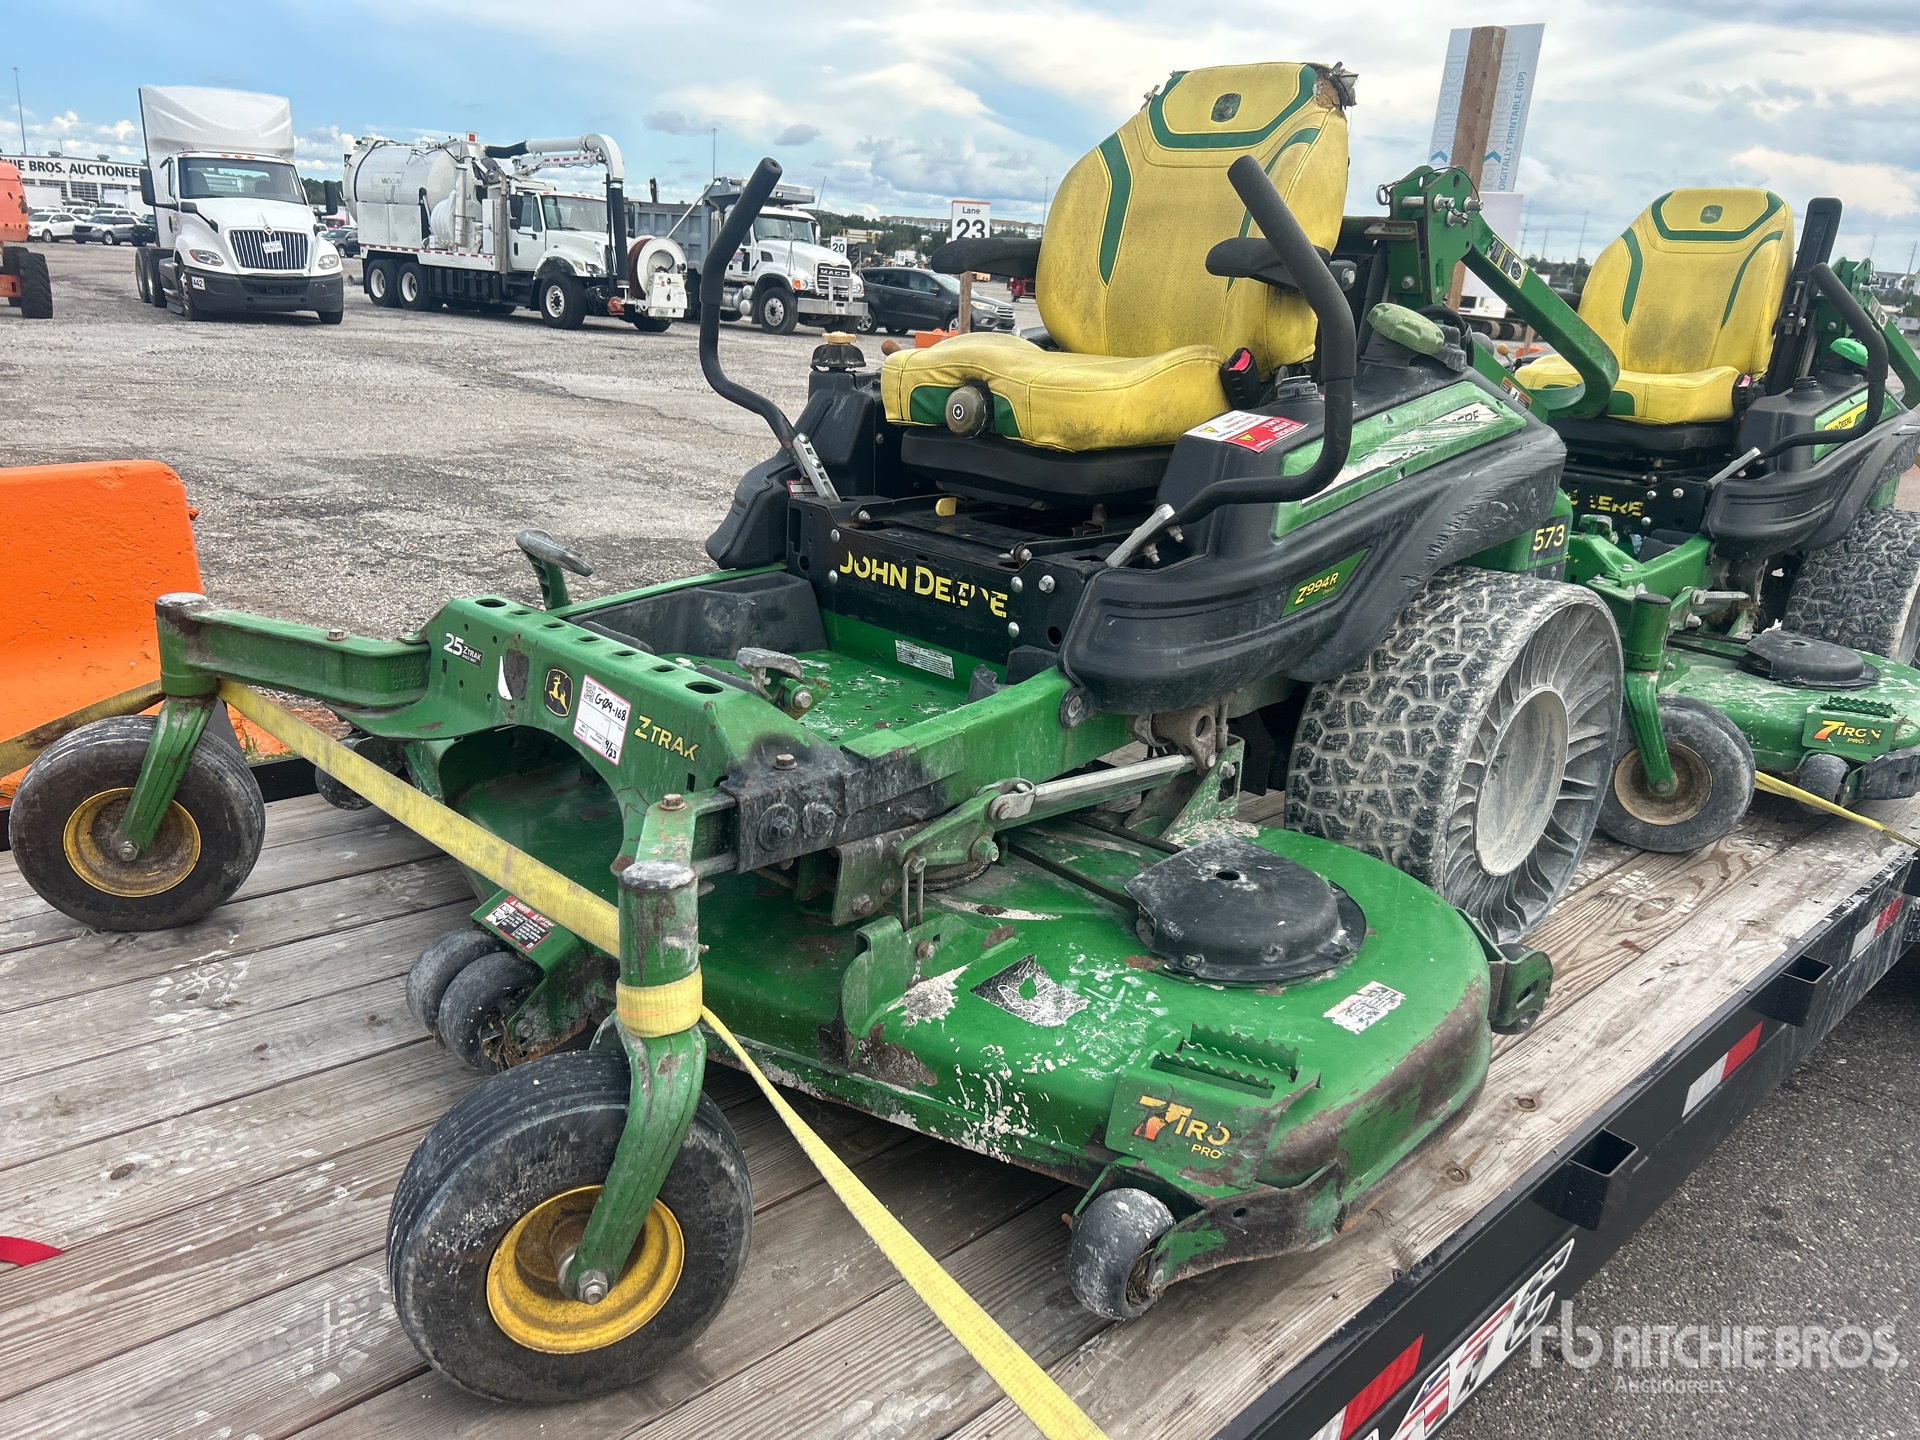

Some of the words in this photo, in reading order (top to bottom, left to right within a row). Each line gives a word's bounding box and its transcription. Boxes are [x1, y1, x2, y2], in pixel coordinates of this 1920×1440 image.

[1497, 144, 1512, 190] DIGITALLY
[1506, 92, 1521, 144] PRINTABLE
[1516, 71, 1528, 91] (DP)
[29, 160, 66, 174] BROS.
[69, 163, 140, 178] AUCTIONEE
[962, 206, 980, 214] Lane
[956, 218, 985, 239] 23
[832, 243, 845, 253] 20
[1532, 524, 1565, 551] 573
[840, 551, 908, 590] JOHN
[1294, 572, 1339, 605] Z994R
[443, 632, 464, 656] 25
[634, 715, 700, 762] ZTRAK
[1191, 1143, 1222, 1159] PRO
